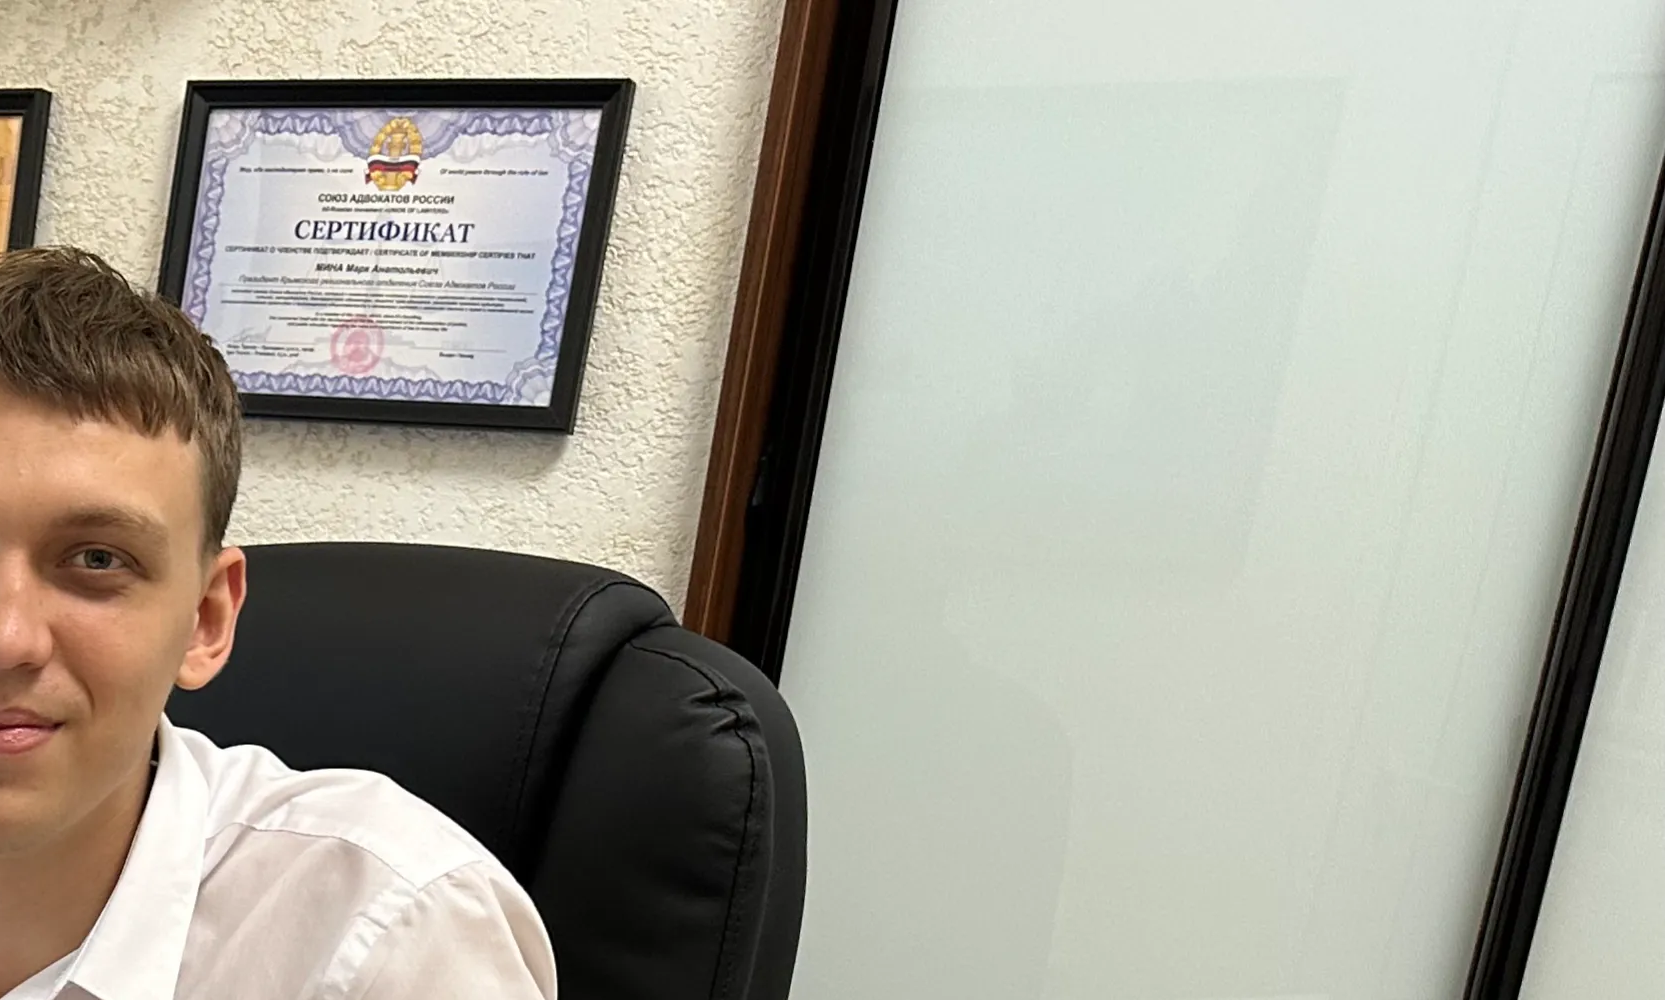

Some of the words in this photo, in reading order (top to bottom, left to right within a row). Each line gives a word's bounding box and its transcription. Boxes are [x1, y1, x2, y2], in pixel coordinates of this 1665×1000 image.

[318, 193, 348, 204] СОЮЗ
[349, 194, 410, 204] АДВОКАТОВ
[412, 195, 455, 205] РОССИИ
[294, 219, 475, 244] СЕРТИФИКАТ
